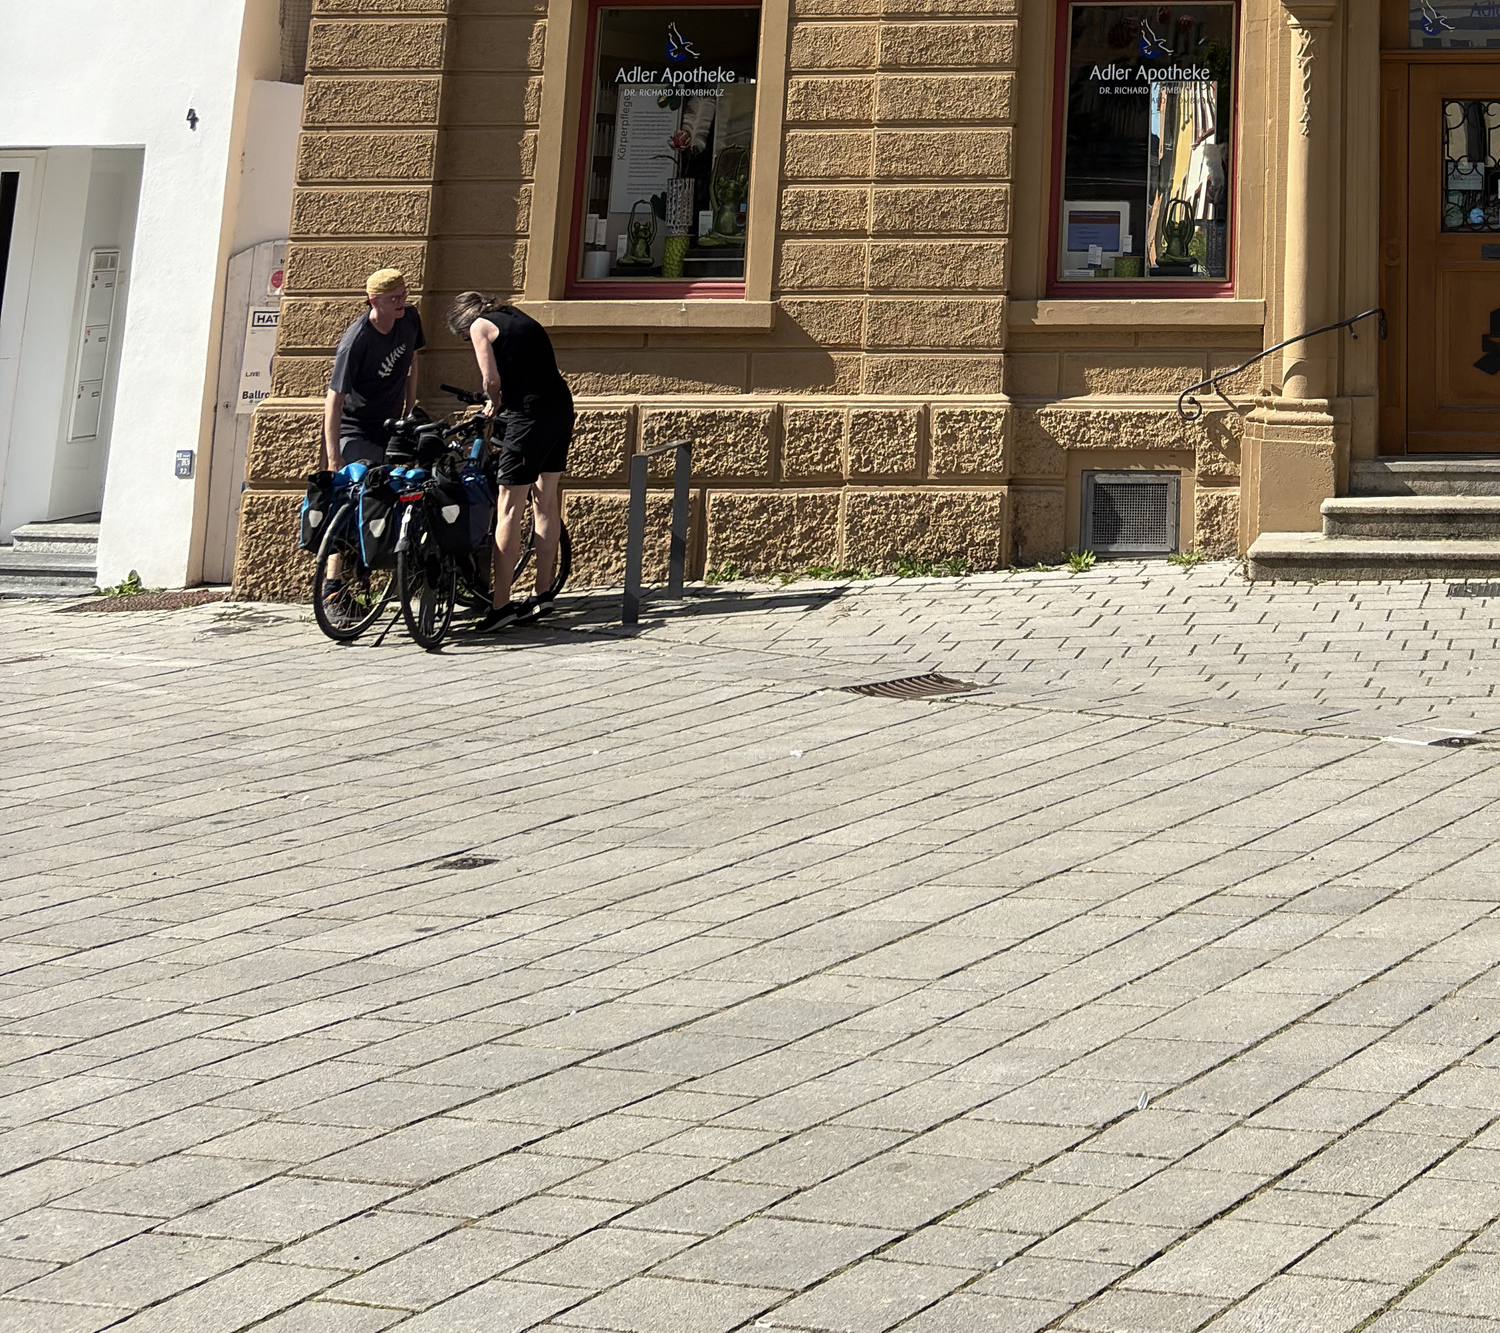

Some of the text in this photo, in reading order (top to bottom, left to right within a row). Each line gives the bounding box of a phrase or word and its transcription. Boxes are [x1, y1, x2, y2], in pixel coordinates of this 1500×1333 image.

[614, 66, 736, 87] Adler Apotheke
[1089, 64, 1210, 84] Adler Apotheke
[624, 89, 725, 97] DR. RICHARD KROMBHOLZ
[186, 108, 199, 131] 4
[616, 95, 633, 161] Körperpflege
